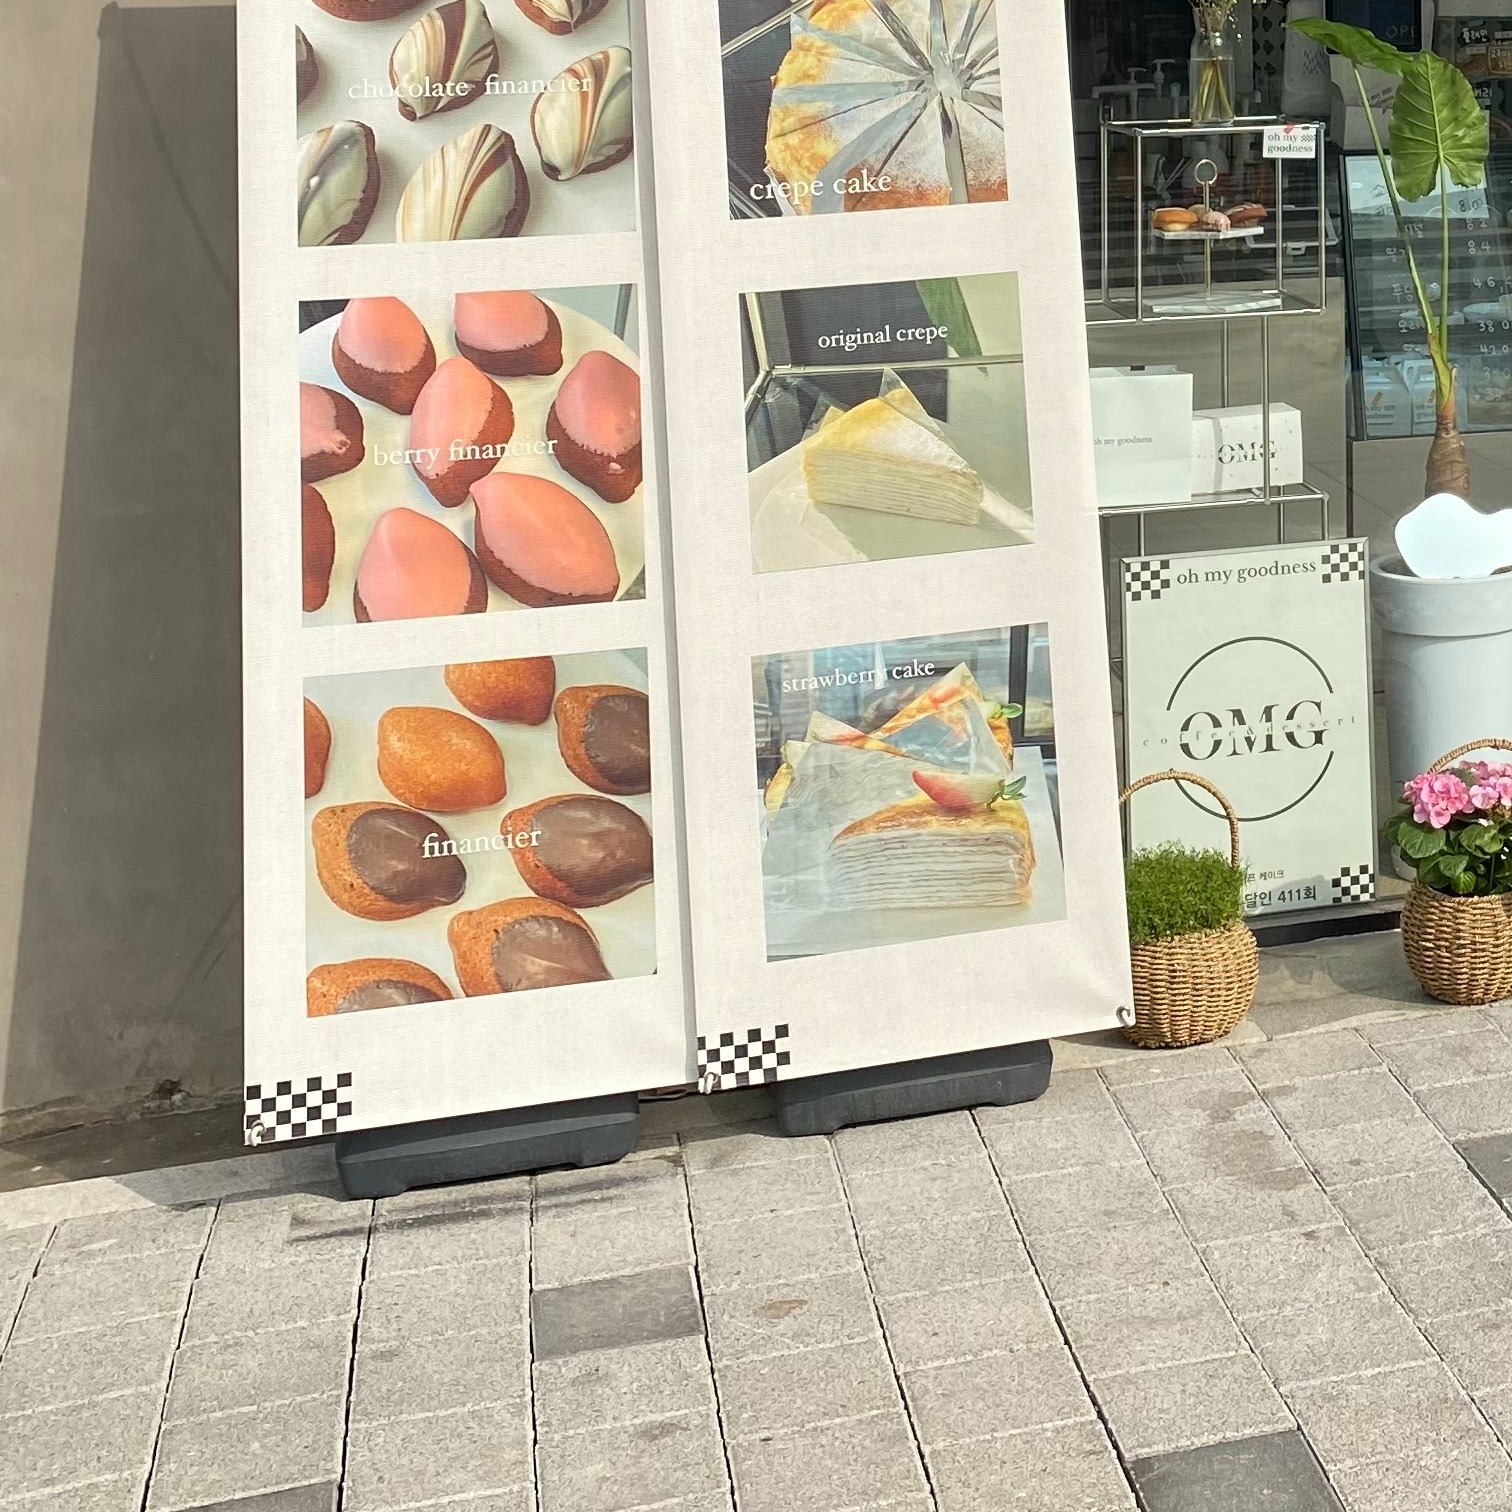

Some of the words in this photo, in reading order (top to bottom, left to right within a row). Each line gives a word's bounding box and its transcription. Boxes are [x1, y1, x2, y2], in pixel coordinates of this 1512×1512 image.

[348, 75, 470, 99] chocolate
[484, 73, 592, 96] financier
[1267, 133, 1281, 142] oh
[1282, 134, 1299, 143] my
[1267, 144, 1313, 154] goodness
[750, 180, 824, 205] crepe
[832, 168, 892, 195] cake
[817, 324, 892, 352] original
[896, 325, 948, 345] crepe
[373, 444, 440, 470] berry
[449, 438, 558, 462] financier
[1217, 440, 1276, 465] OMG
[1176, 569, 1199, 585] oh
[1204, 570, 1233, 586] my
[1237, 560, 1317, 584] goodness
[782, 667, 888, 694] strawberry
[892, 658, 935, 680] cake
[1179, 700, 1330, 761] OMG
[422, 826, 542, 859] financier
[1259, 869, 1285, 881] 케이크
[1277, 885, 1317, 903] 411회
